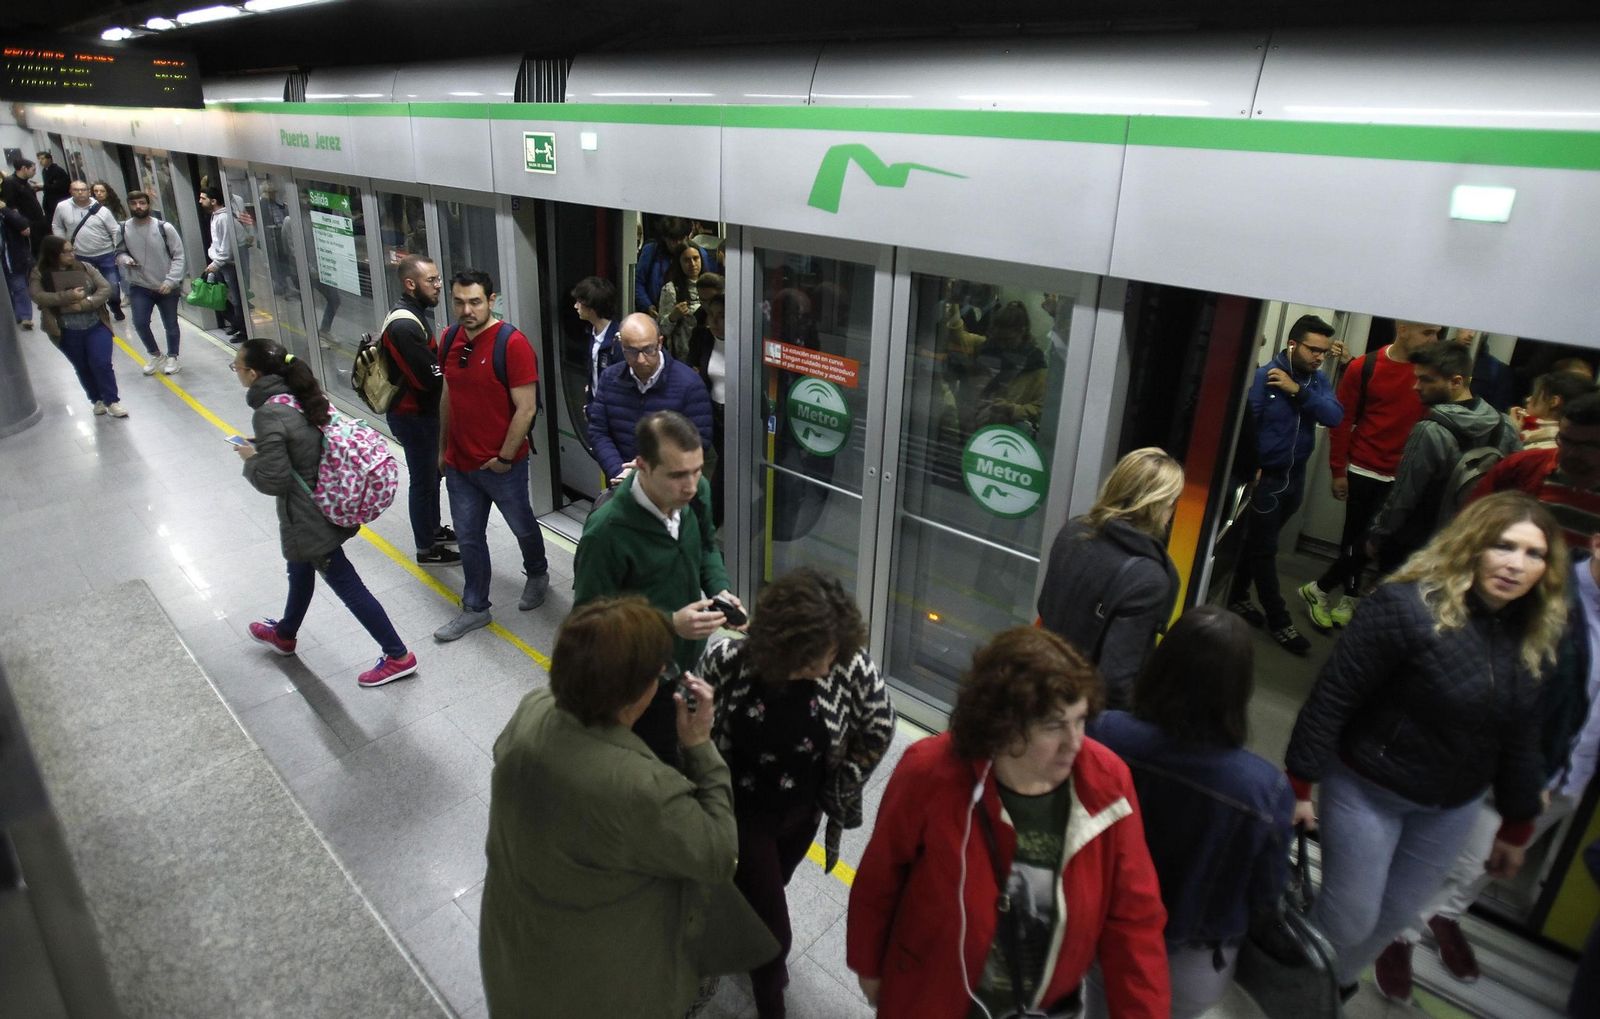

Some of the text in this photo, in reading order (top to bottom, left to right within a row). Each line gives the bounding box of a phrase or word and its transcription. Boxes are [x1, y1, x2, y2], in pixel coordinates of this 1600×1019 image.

[280, 129, 341, 151] Puerta Jerez
[310, 191, 329, 206] Salida
[789, 347, 810, 357] estación
[782, 353, 801, 363] Tengan
[801, 358, 822, 368] cuidado
[829, 364, 856, 377] introducir
[795, 364, 809, 372] entre
[809, 367, 825, 376] coche
[797, 404, 839, 428] Metro
[976, 458, 1033, 486] Metro
